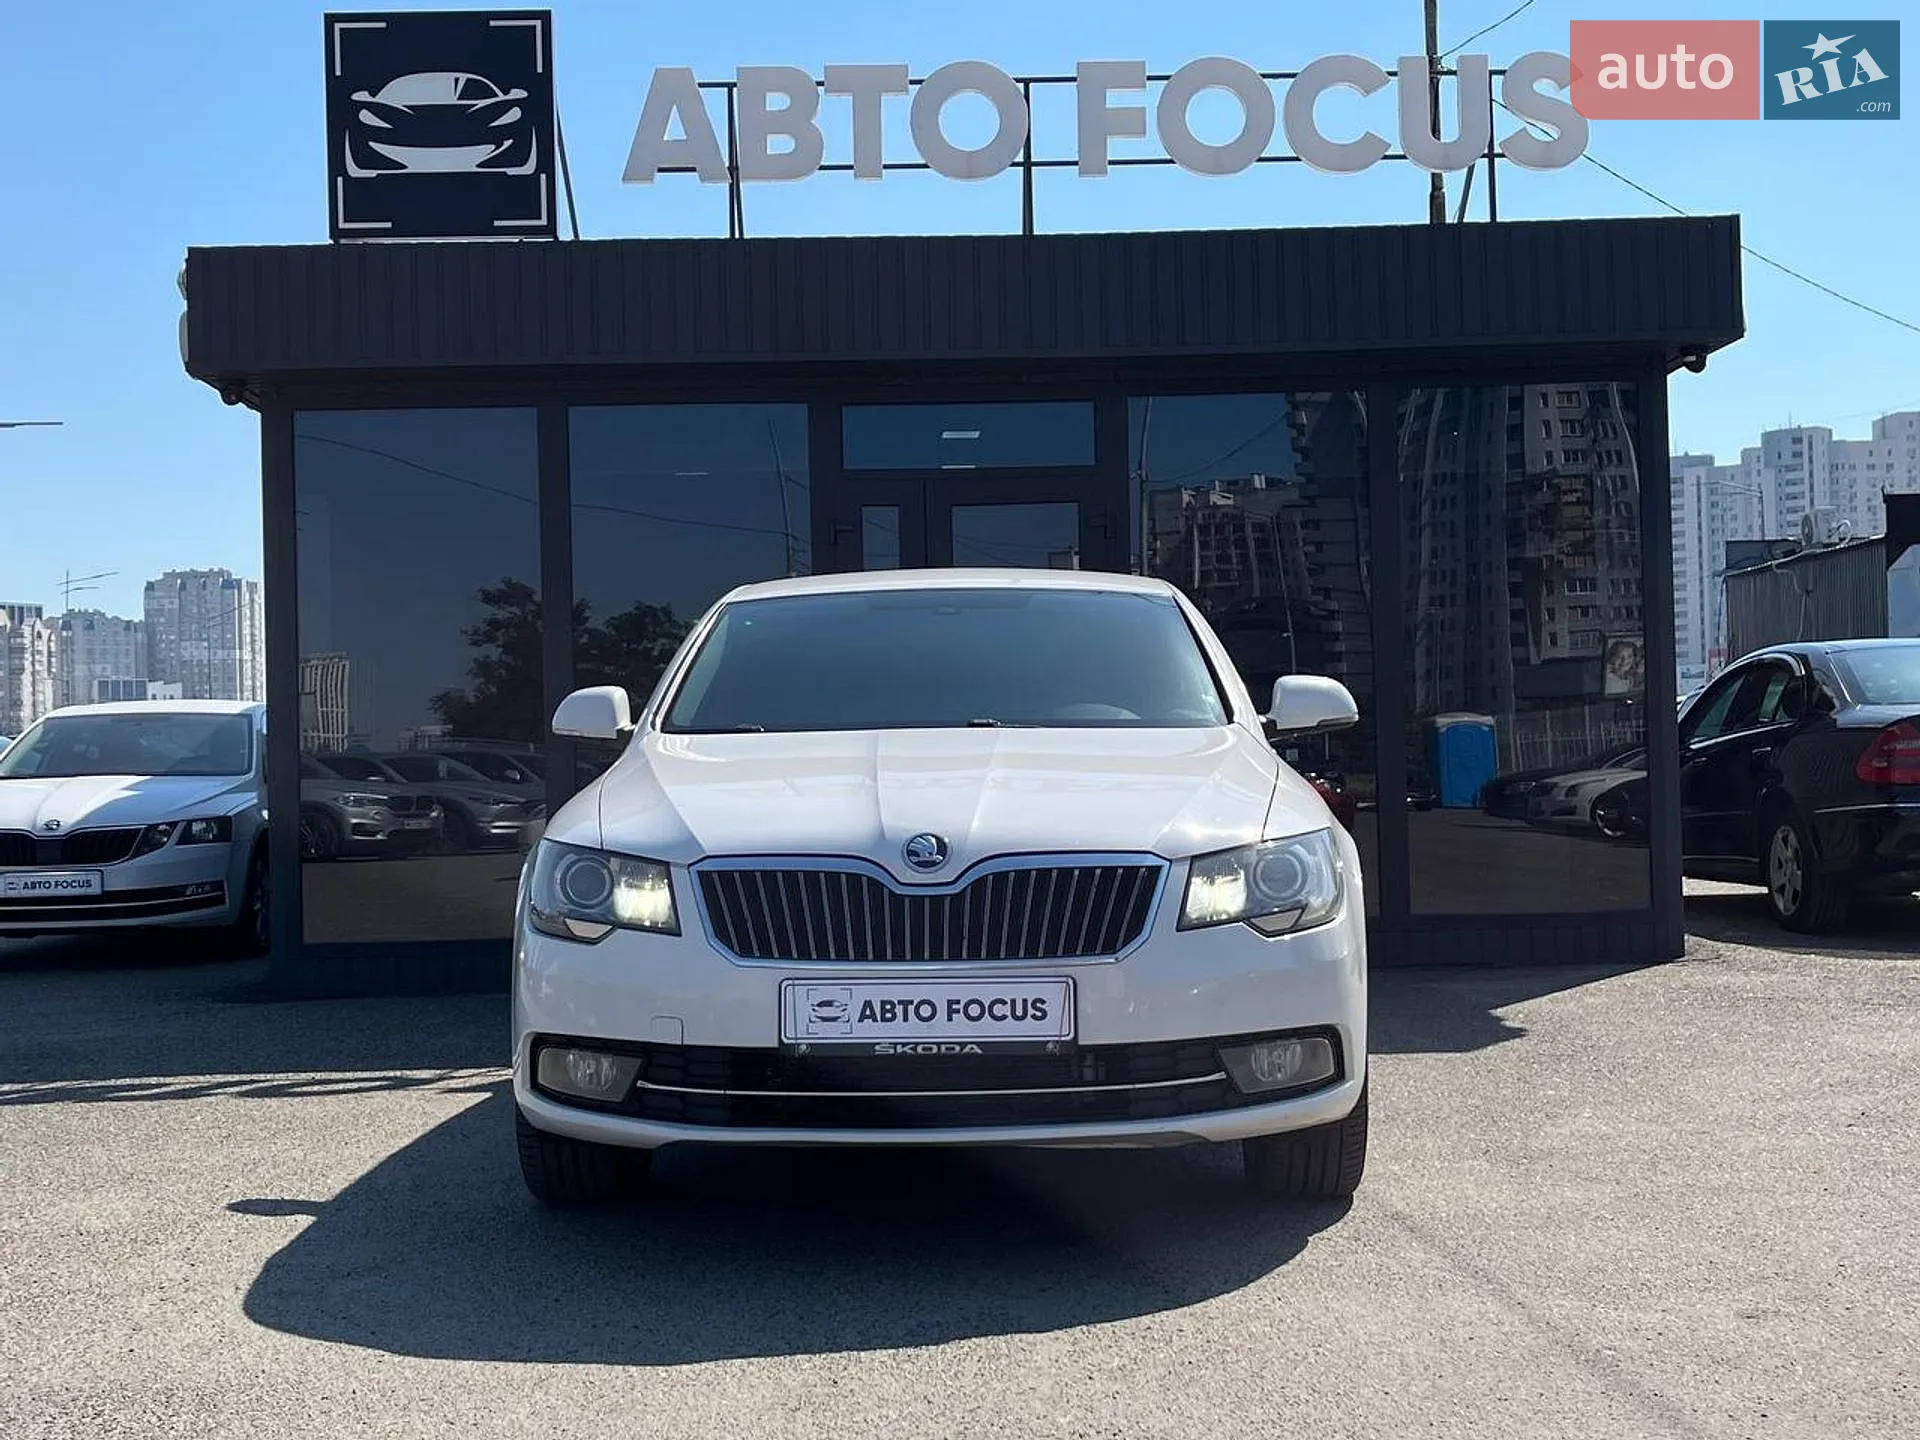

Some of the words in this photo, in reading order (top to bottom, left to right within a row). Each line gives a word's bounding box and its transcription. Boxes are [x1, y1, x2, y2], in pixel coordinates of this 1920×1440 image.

[622, 60, 1029, 184] АВТО
[1076, 51, 1590, 177] FOCUS
[22, 880, 52, 890] АВТО
[54, 879, 92, 889] FOCUS
[857, 998, 937, 1023] АВТО
[946, 997, 1048, 1022] FOCUS
[873, 1042, 984, 1055] ŠKODA
